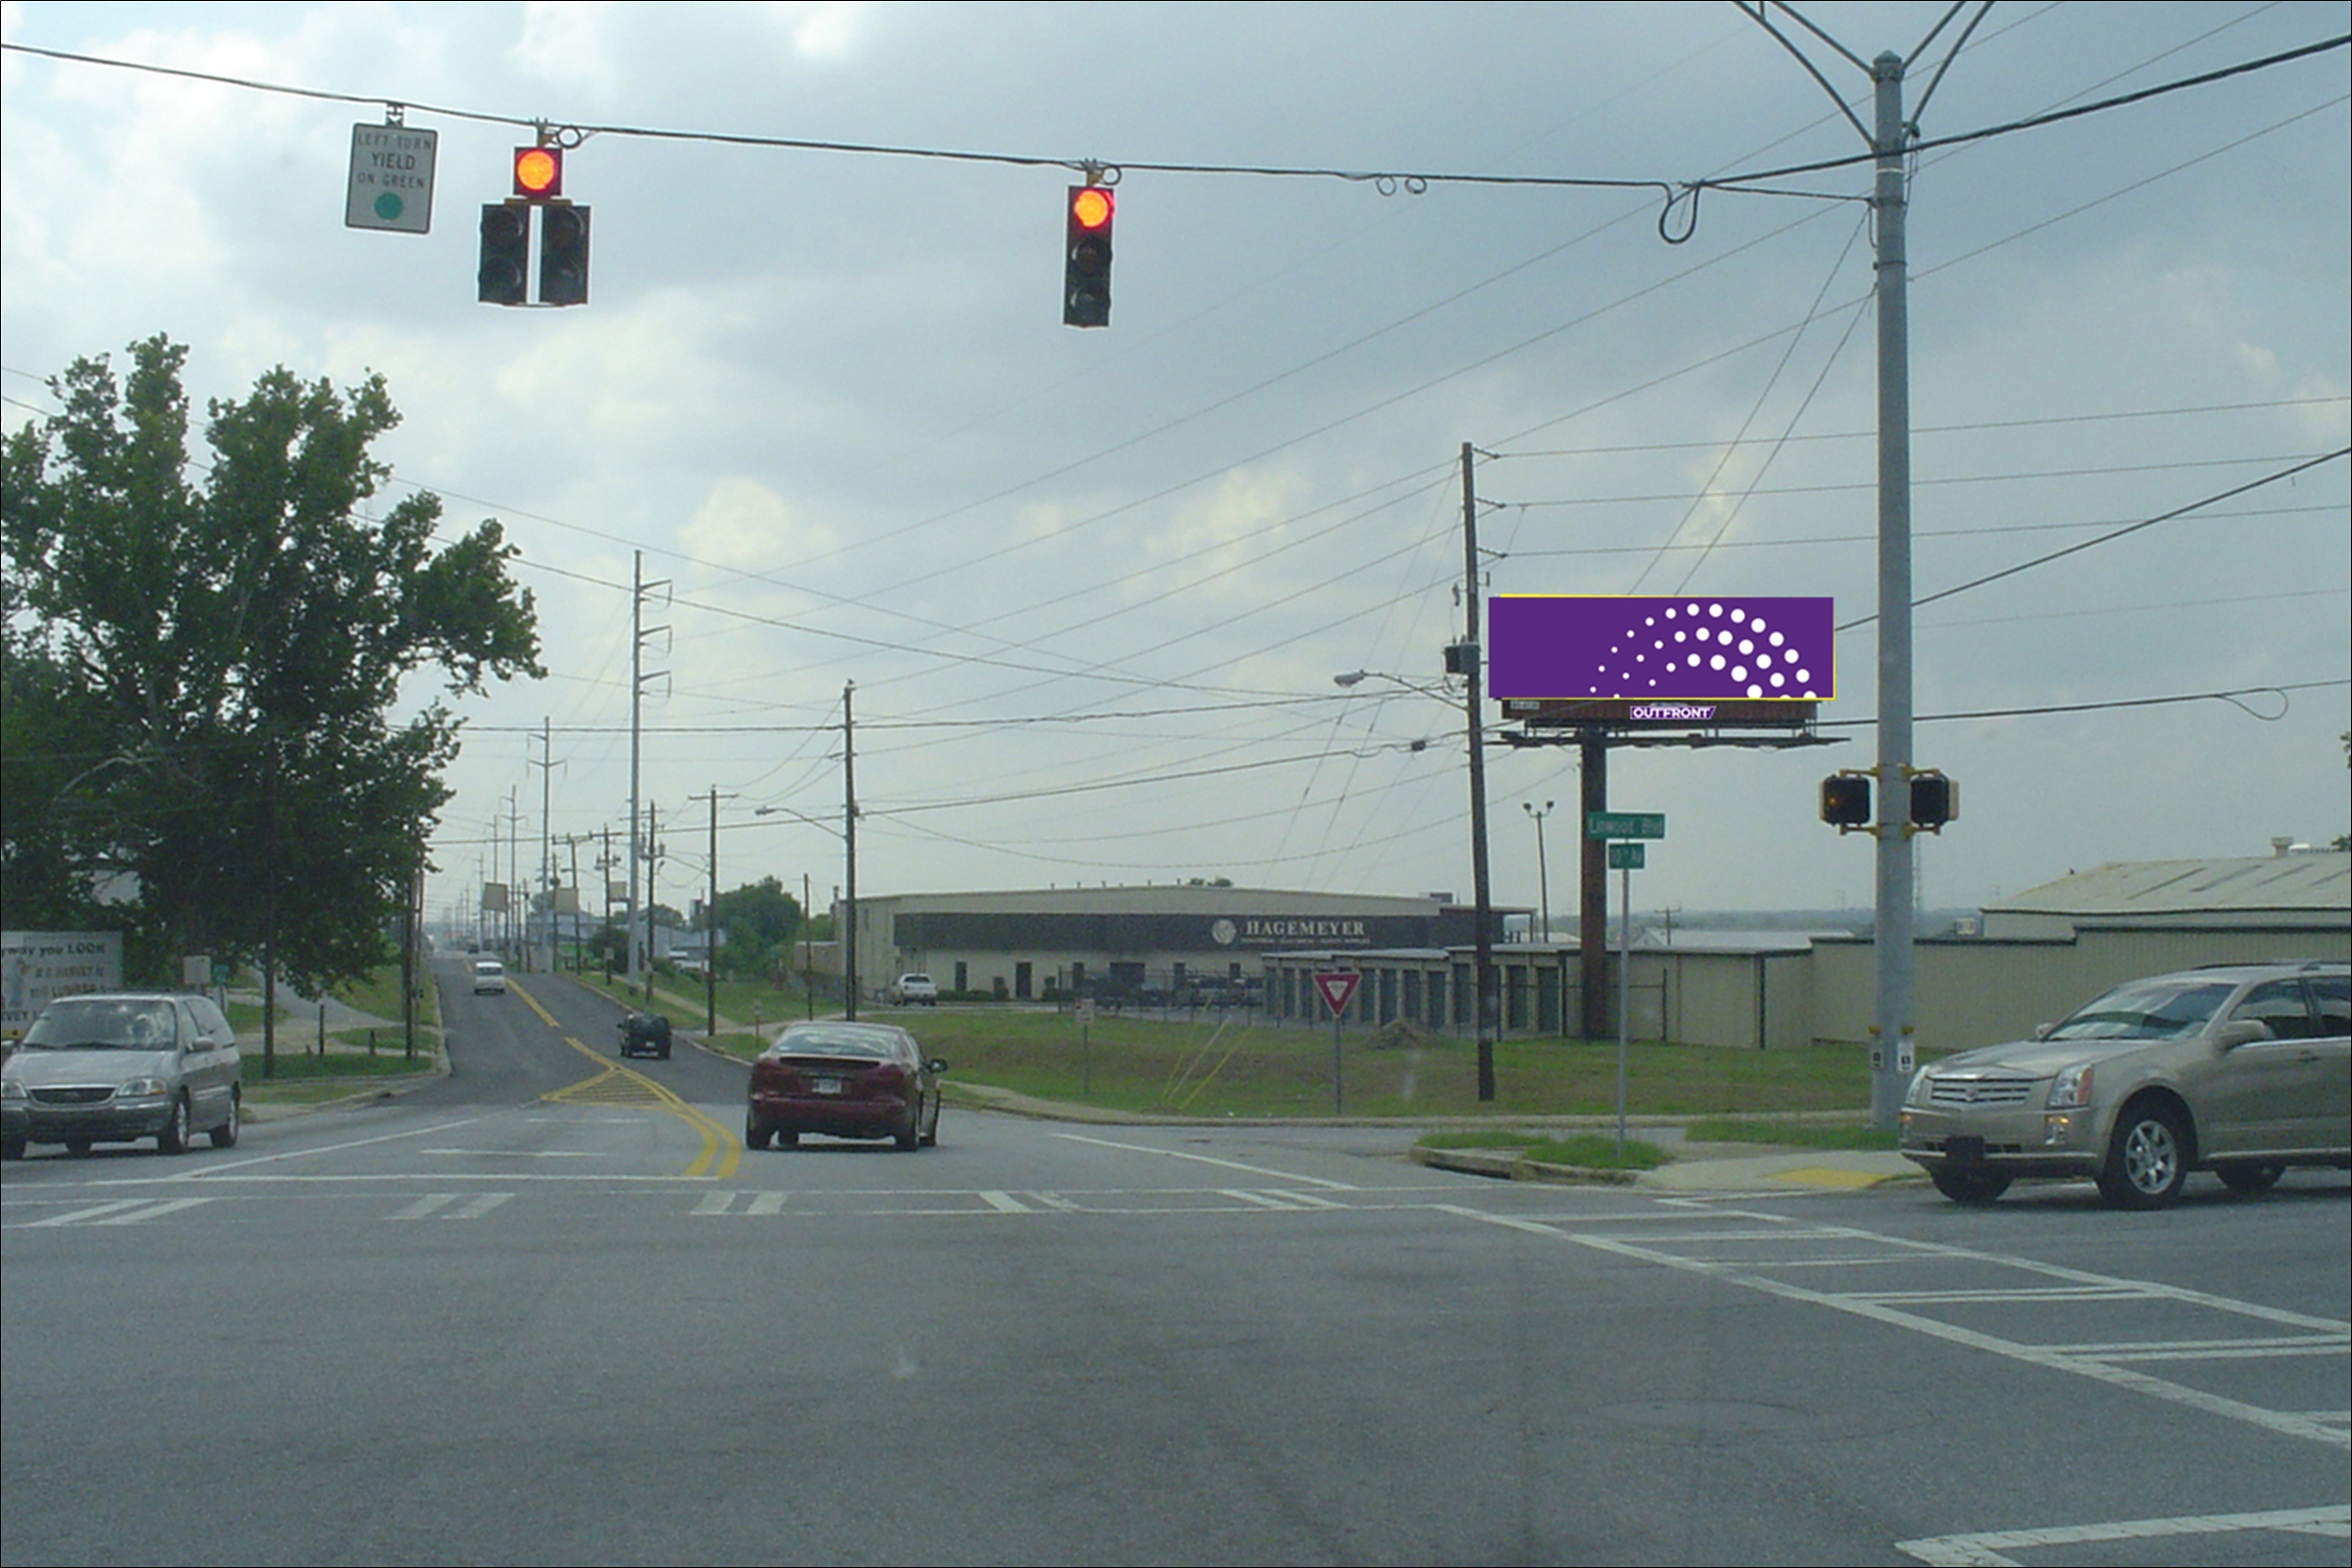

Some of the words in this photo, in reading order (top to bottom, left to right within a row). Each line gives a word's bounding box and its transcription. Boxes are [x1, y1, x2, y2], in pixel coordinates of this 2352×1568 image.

[357, 132, 389, 146] LEFT
[397, 135, 432, 150] TURN
[371, 152, 416, 171] YIELD
[357, 172, 374, 184] ON
[382, 173, 425, 189] GREEN
[1633, 707, 1710, 718] OUTFRONT
[1247, 920, 1365, 936] HAGEMEYER
[68, 942, 106, 955] LOOK
